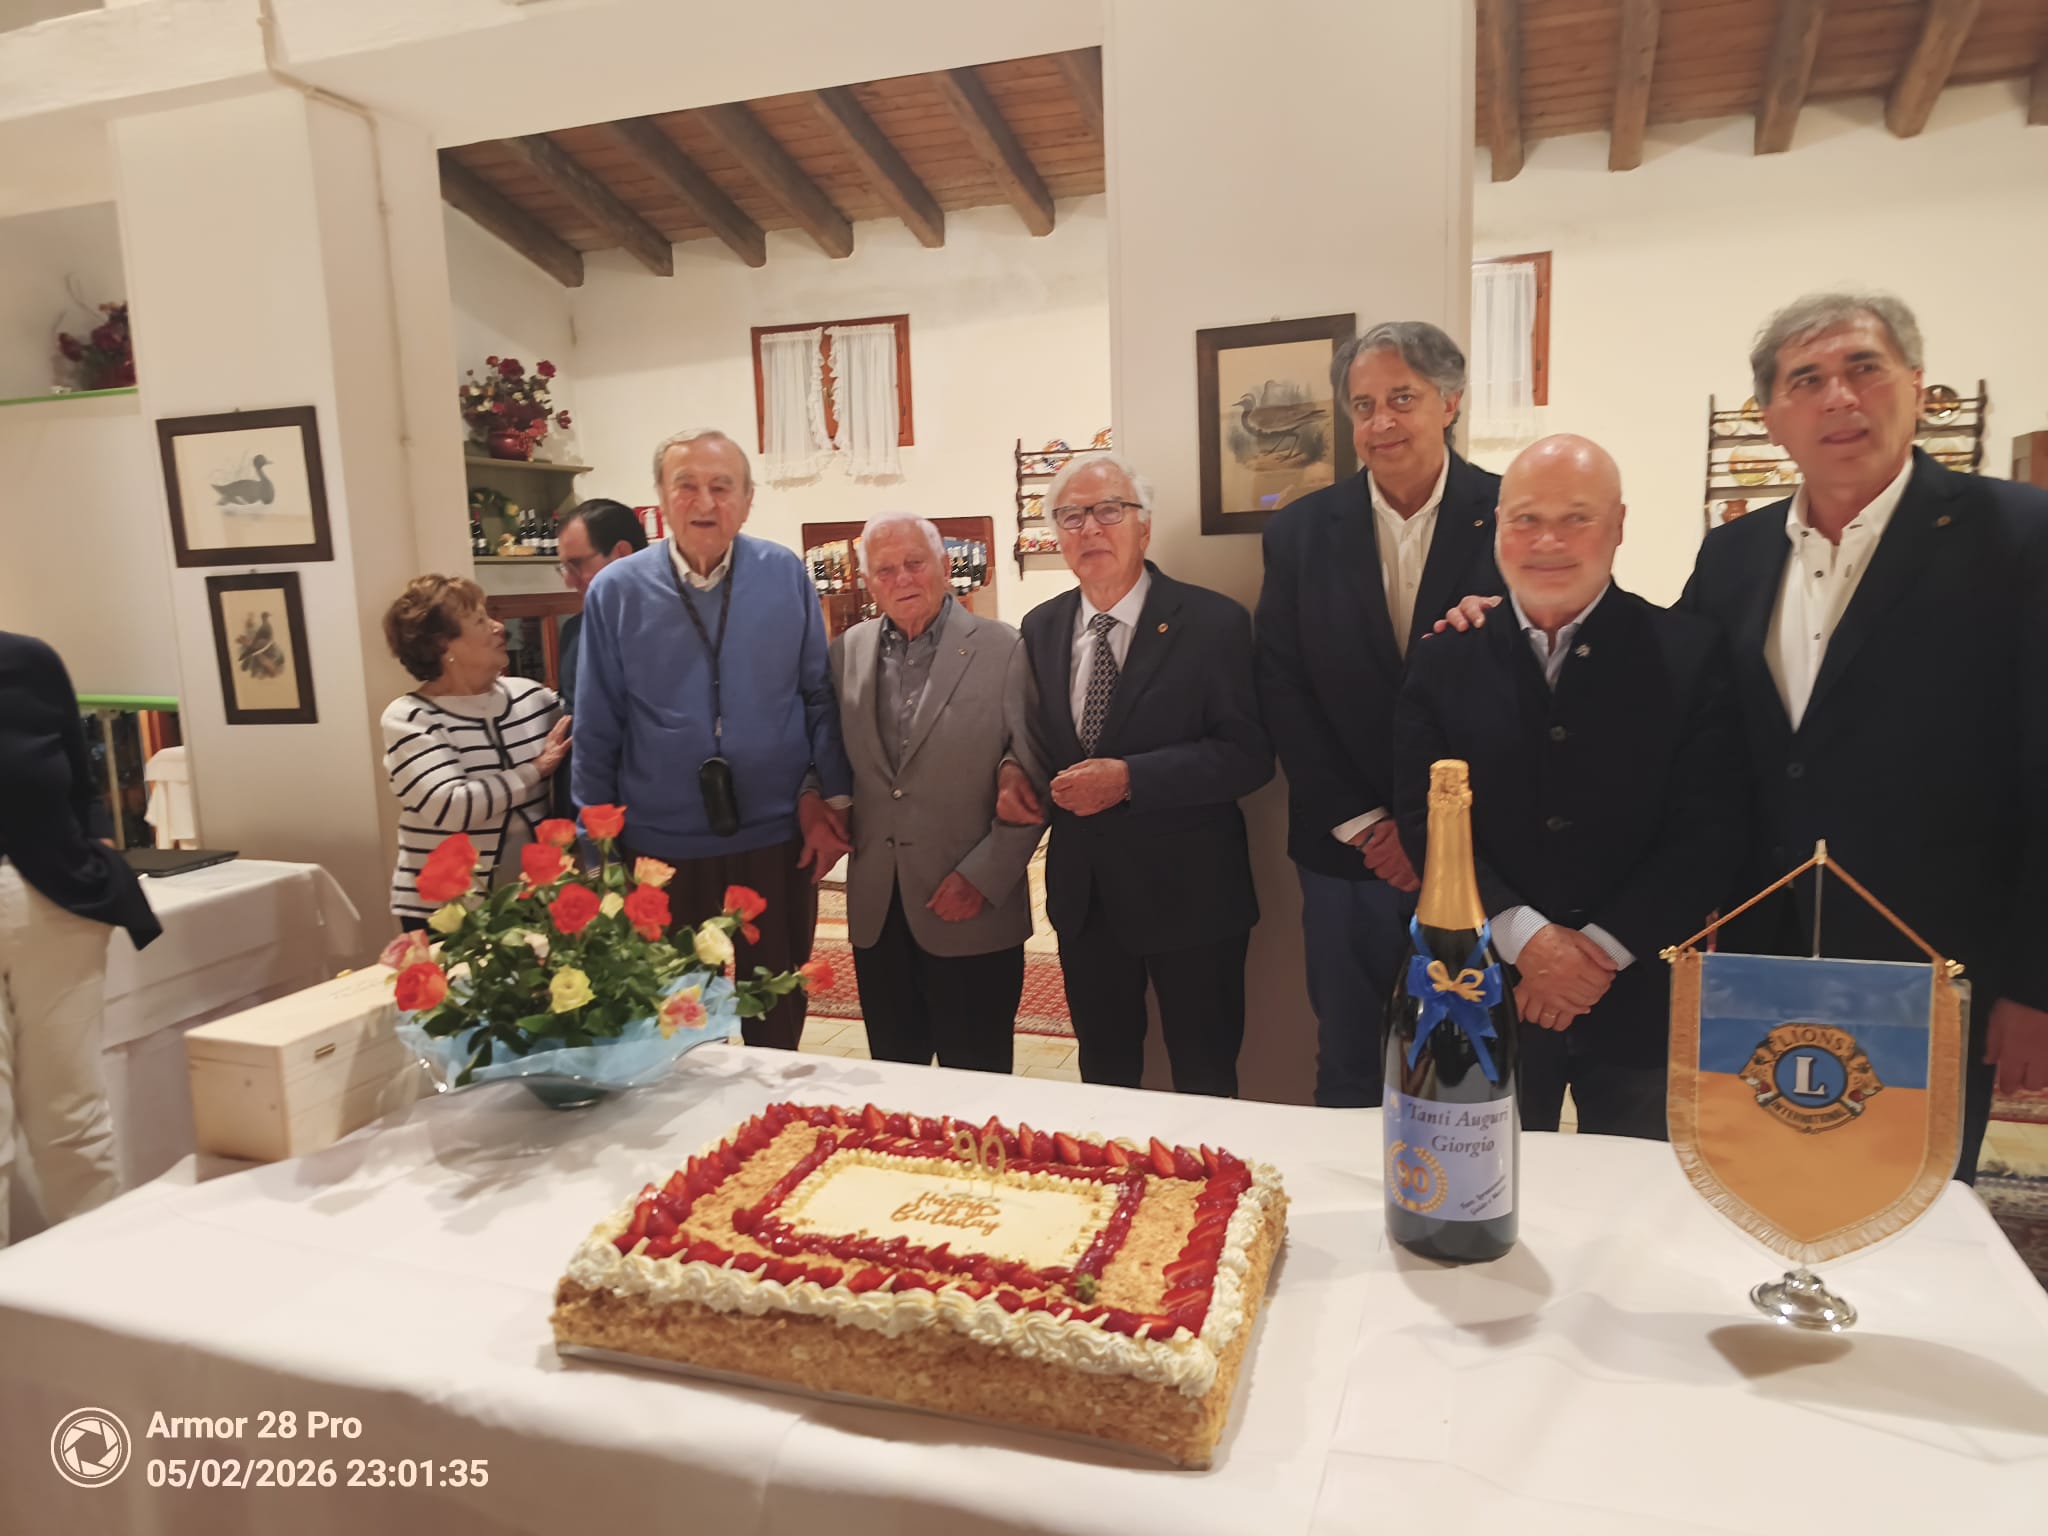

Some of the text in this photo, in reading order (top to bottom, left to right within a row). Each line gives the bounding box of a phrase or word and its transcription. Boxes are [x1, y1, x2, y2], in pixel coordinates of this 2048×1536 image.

[1778, 1028, 1845, 1051] LIONS
[1793, 1056, 1826, 1096] L
[1408, 1103, 1509, 1131] Tanti Auguri
[954, 1129, 1006, 1176] 90
[1431, 1135, 1495, 1158] Giorgio
[1396, 1160, 1430, 1194] 90
